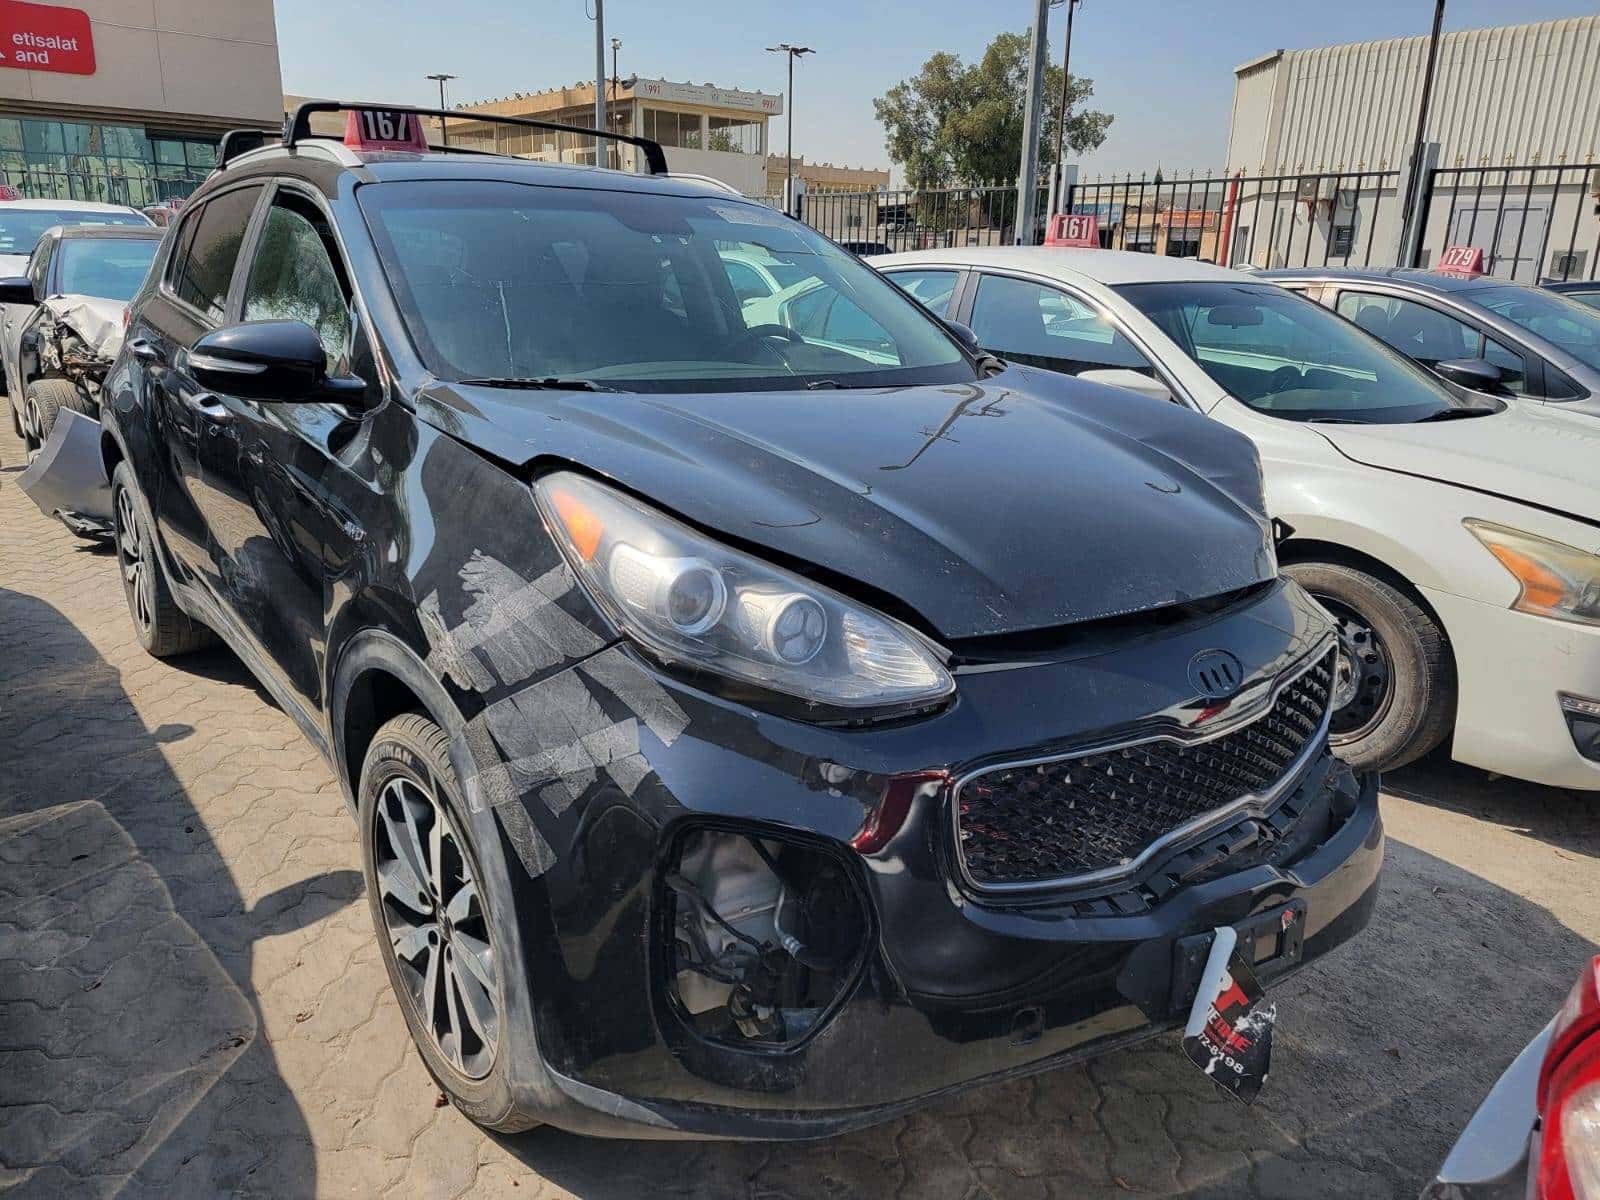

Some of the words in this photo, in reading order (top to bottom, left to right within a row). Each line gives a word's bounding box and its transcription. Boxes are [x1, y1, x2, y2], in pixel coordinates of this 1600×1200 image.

[12, 32, 79, 51] etisalat
[16, 50, 49, 64] and
[1062, 217, 1089, 240] 161
[1447, 248, 1474, 266] 179
